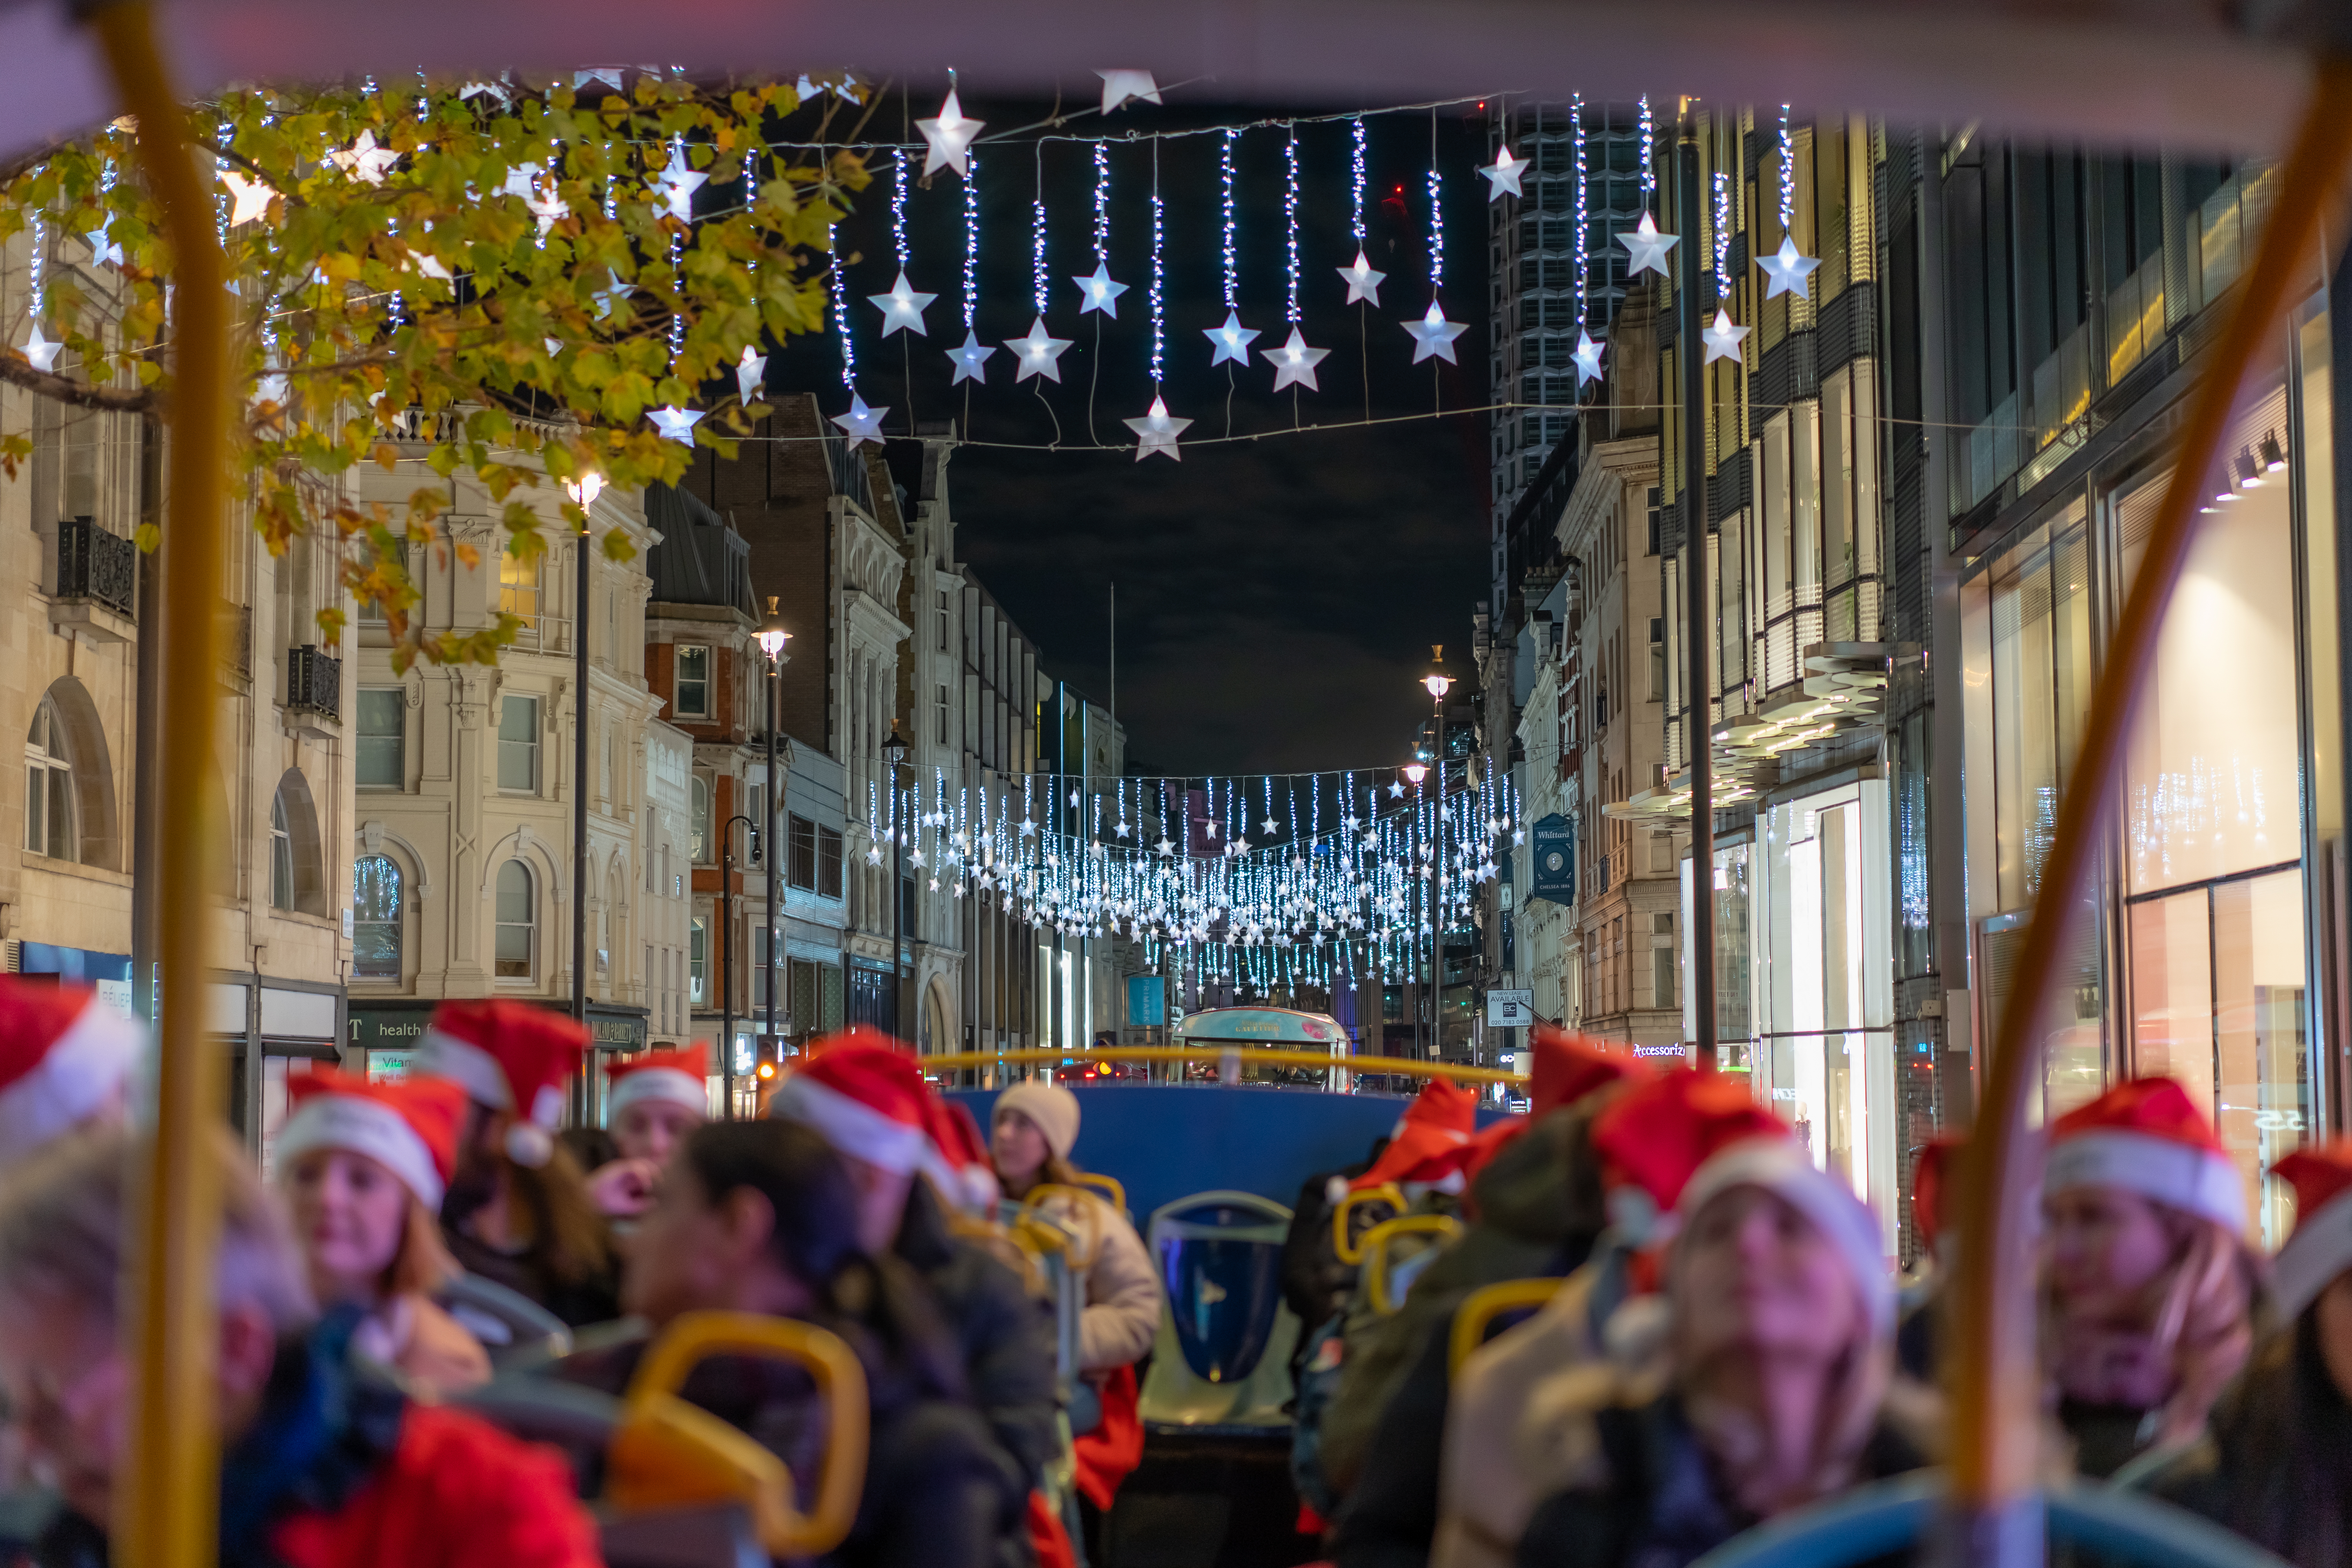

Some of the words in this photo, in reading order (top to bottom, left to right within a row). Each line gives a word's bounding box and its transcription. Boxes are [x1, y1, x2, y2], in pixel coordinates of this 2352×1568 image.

[379, 1023, 421, 1036] health
[592, 1021, 610, 1041] HOLLAND
[614, 1023, 632, 1043] BARRETT
